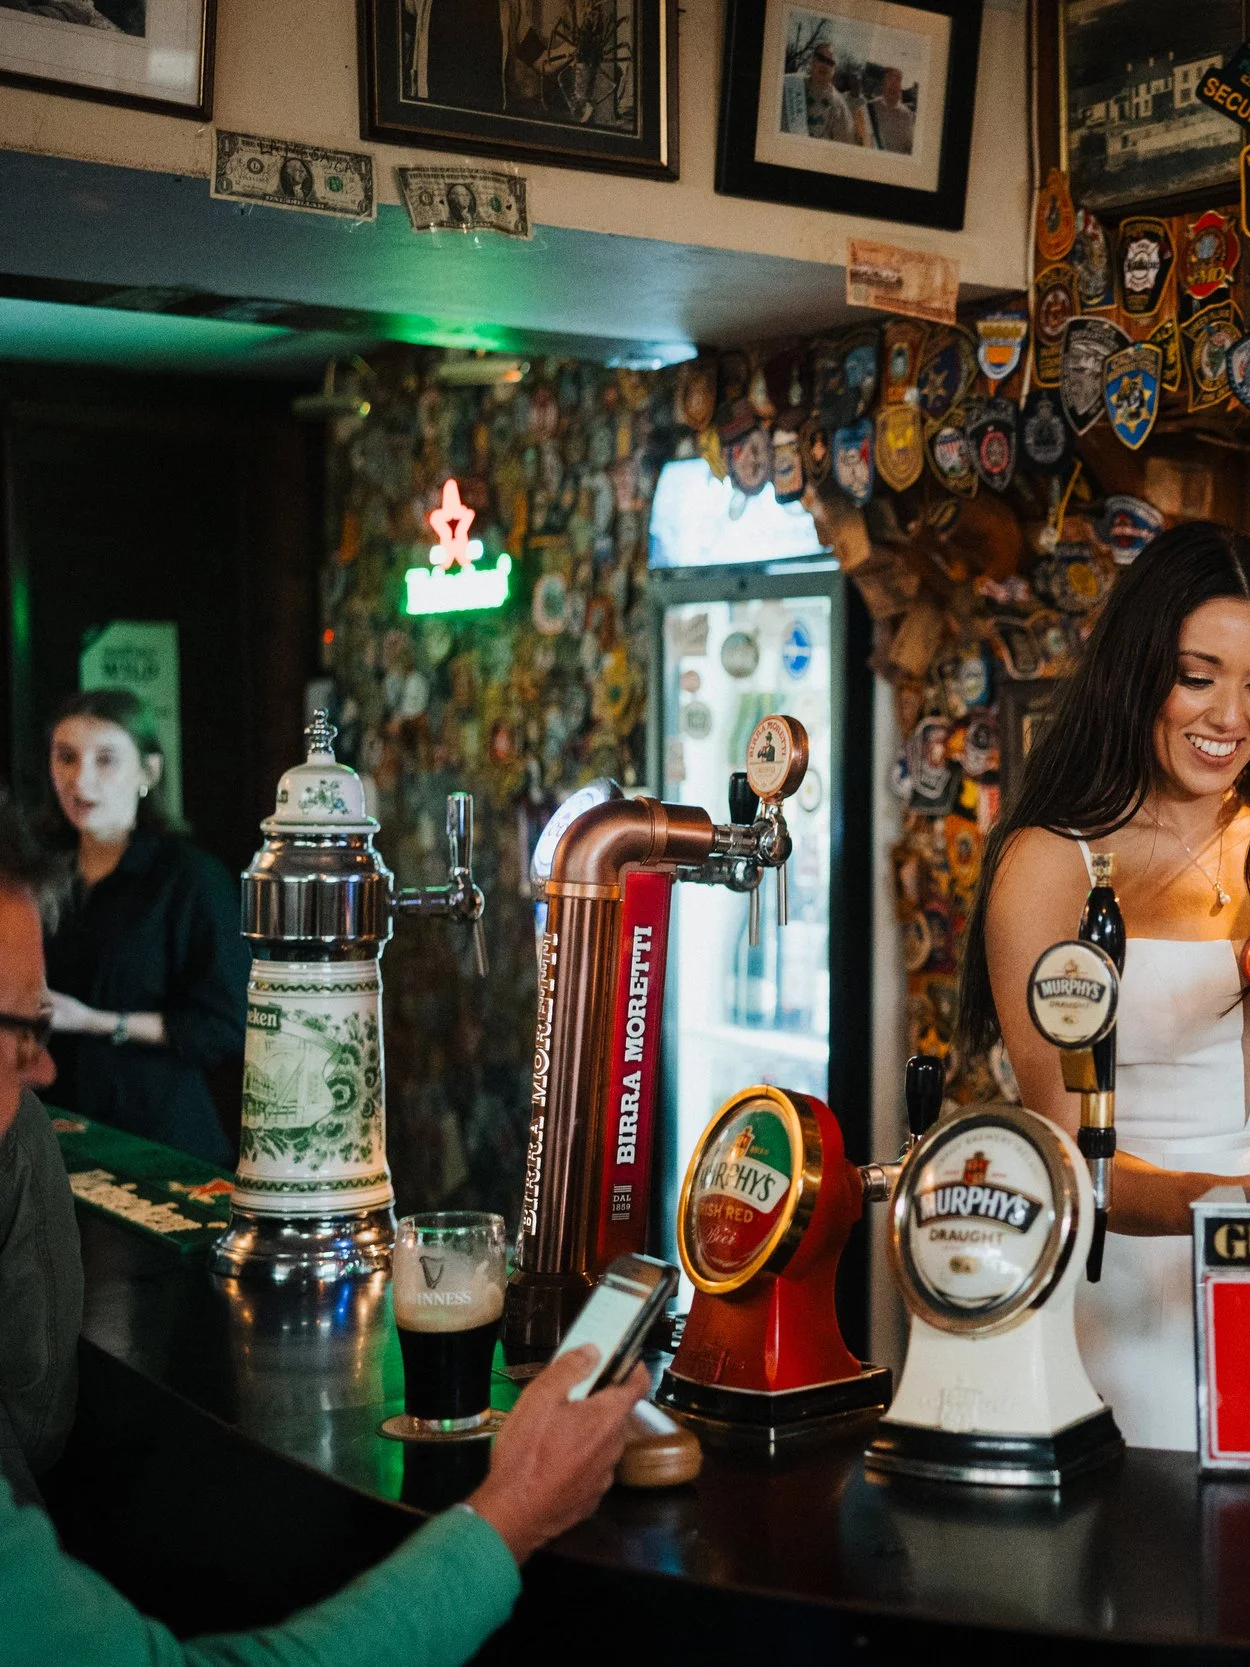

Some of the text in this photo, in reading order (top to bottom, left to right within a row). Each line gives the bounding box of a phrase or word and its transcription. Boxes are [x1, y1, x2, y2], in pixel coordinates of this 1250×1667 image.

[616, 926, 653, 1165] BIRRA MORETTI
[522, 933, 558, 1237] BIRRA MORETTI
[612, 1202, 631, 1212] 1859
[613, 1194, 632, 1203] DAL
[920, 1184, 1031, 1226] MURPHY'S
[725, 1205, 754, 1224] RED
[703, 1224, 737, 1246] Beer
[929, 1227, 1005, 1242] DRAUGHT
